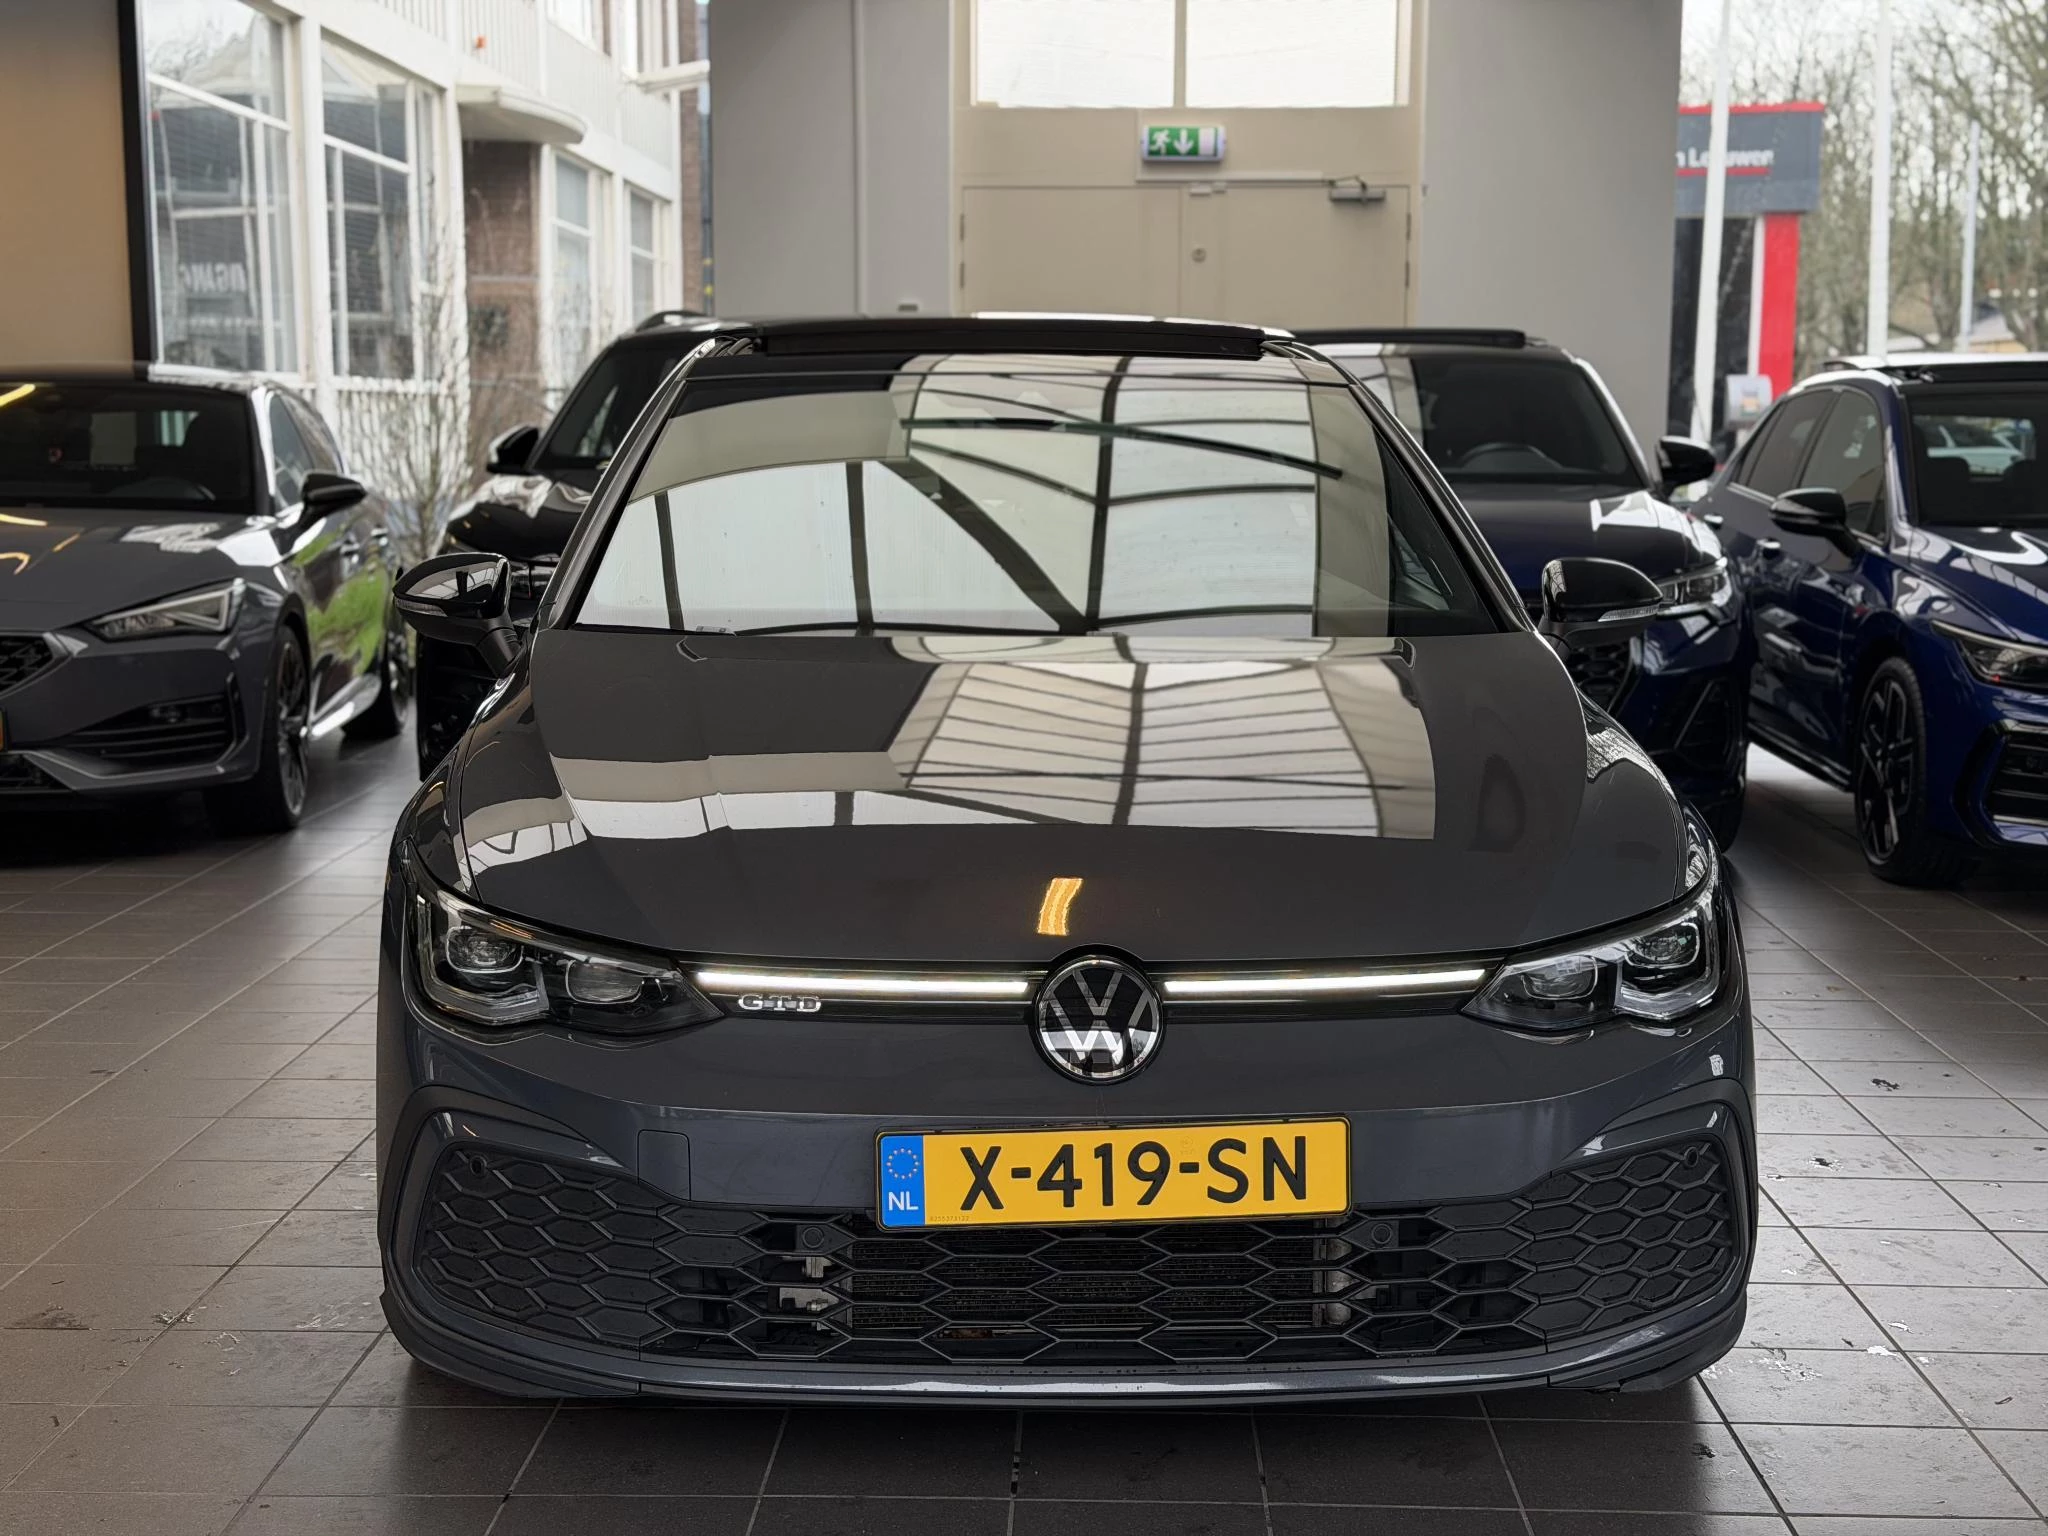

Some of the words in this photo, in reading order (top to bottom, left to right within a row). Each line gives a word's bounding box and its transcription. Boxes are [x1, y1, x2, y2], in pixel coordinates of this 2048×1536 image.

[738, 993, 821, 1012] GTD
[960, 1135, 1307, 1211] X-419-SN
[888, 1191, 919, 1211] NL
